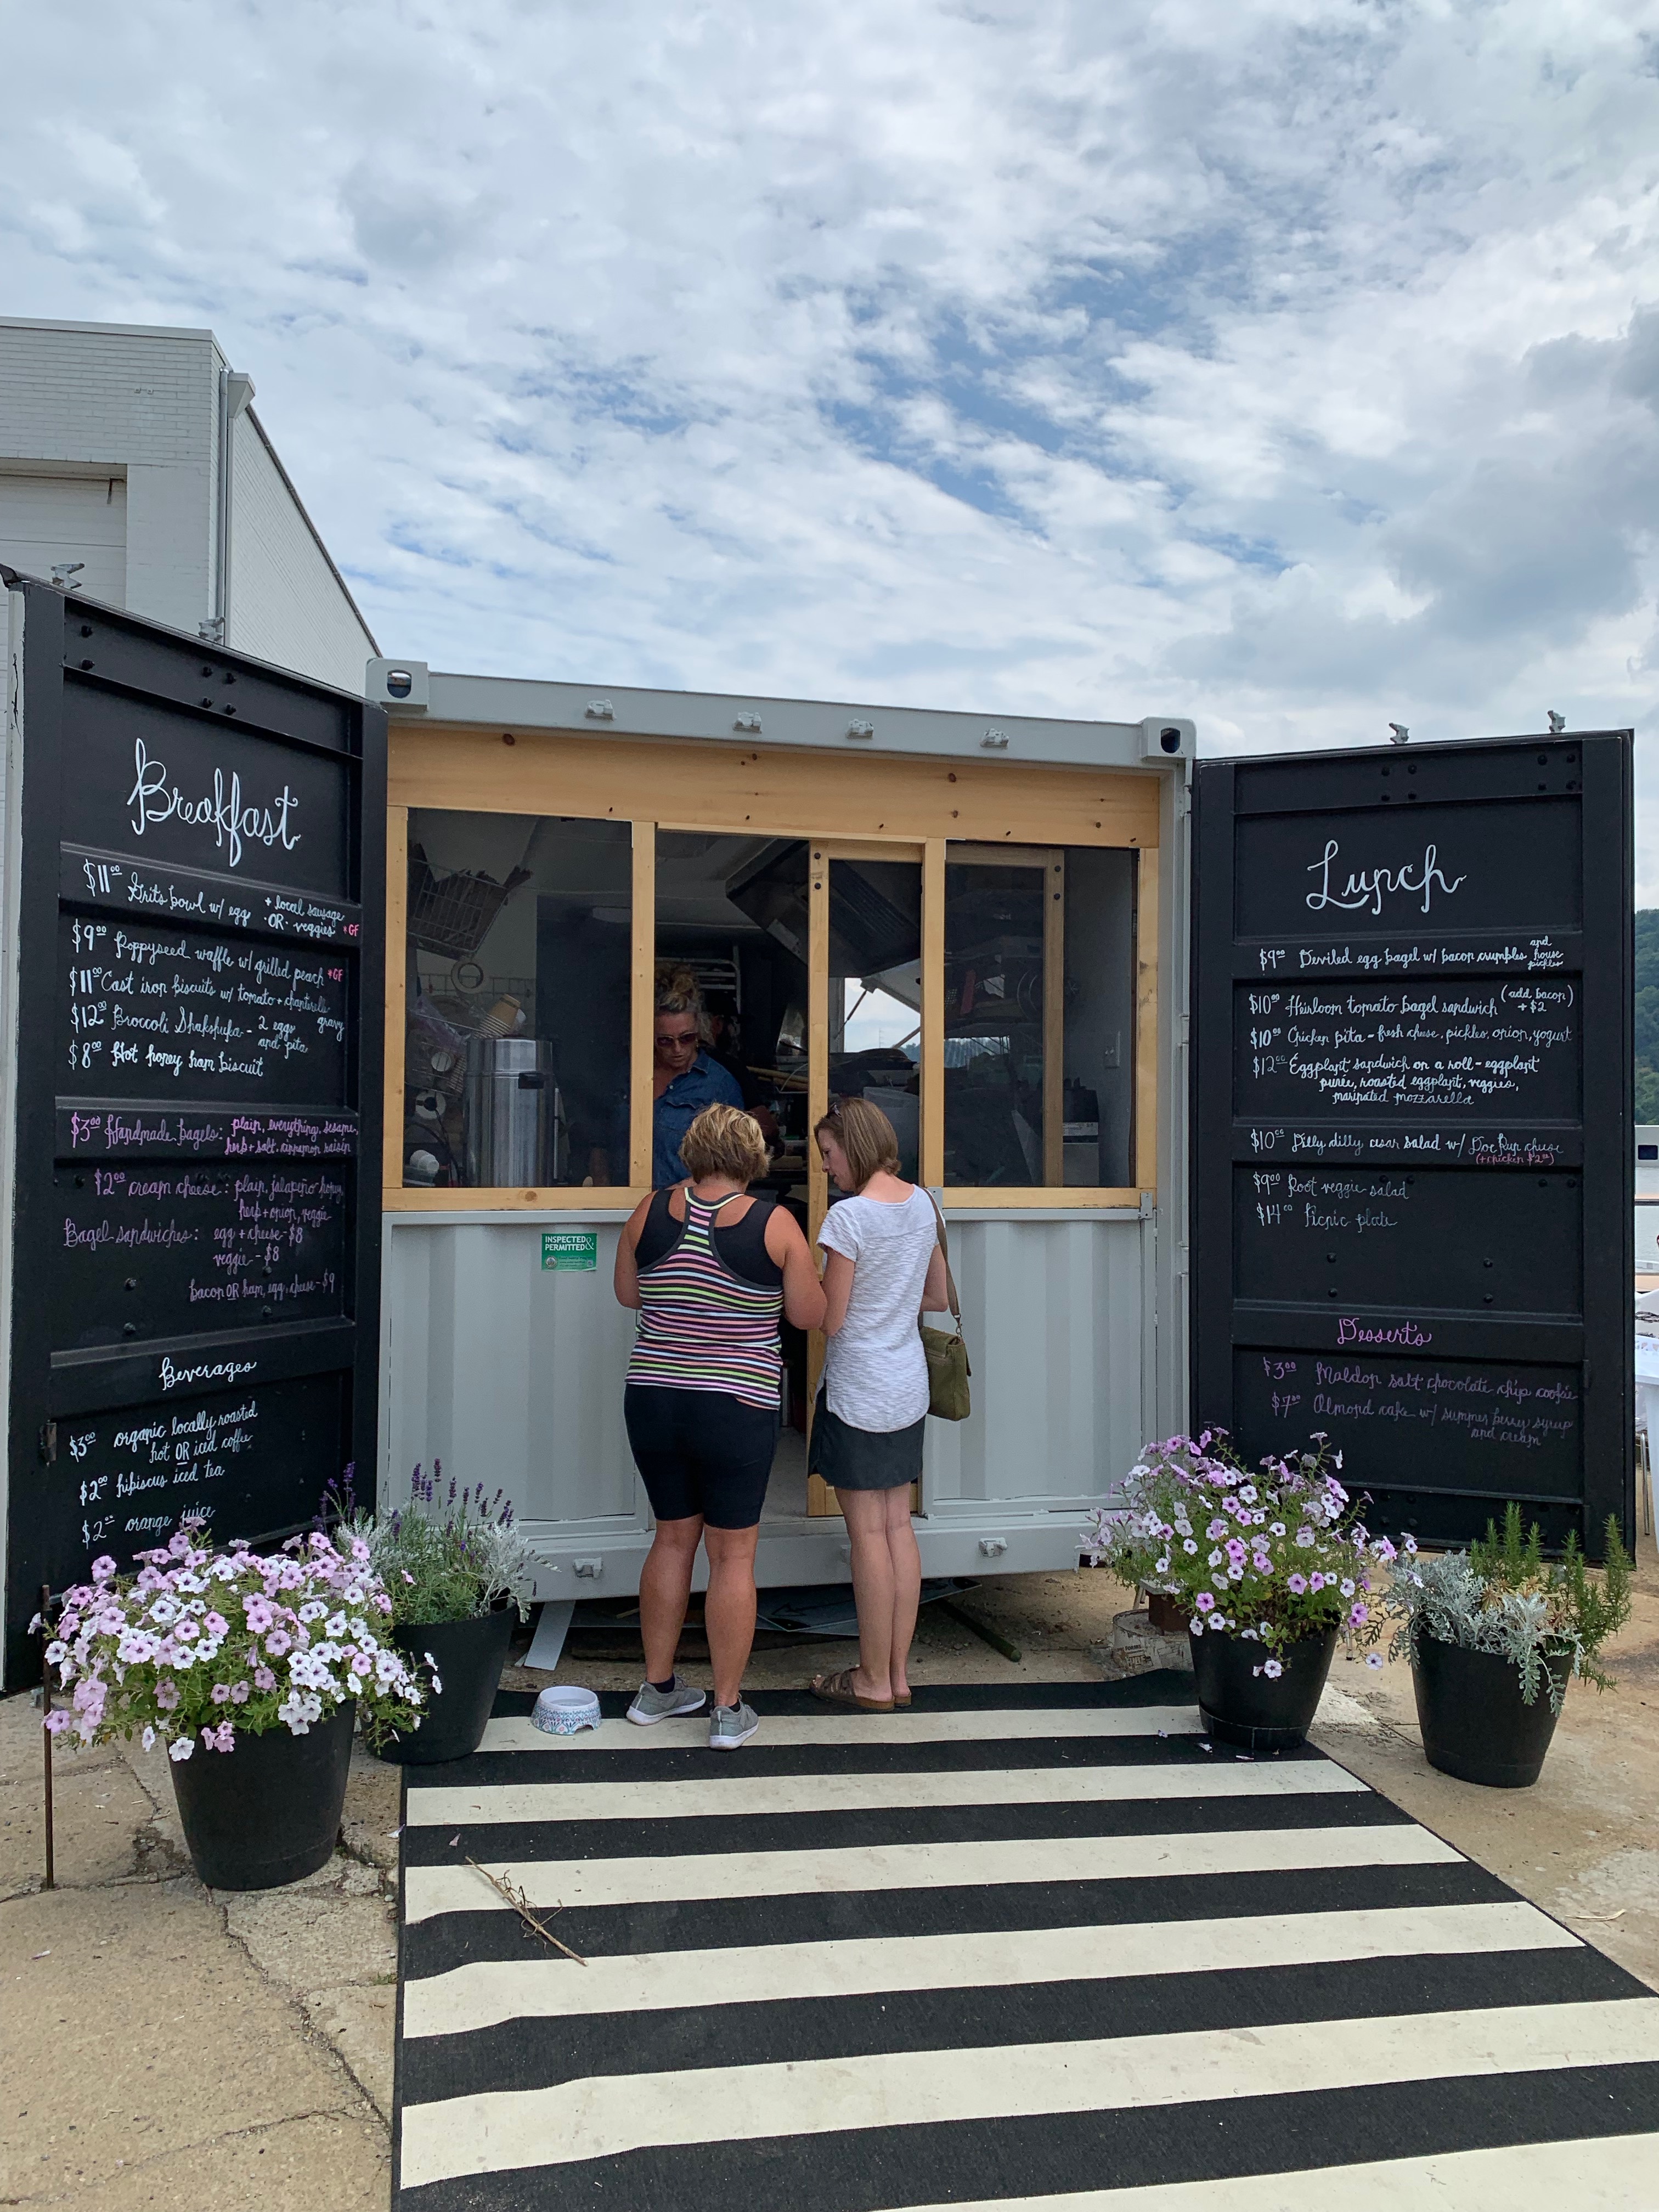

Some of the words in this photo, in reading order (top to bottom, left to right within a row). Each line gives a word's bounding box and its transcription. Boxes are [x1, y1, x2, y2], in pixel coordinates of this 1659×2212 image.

[127, 738, 301, 867] Breakfast
[1306, 839, 1467, 915] Lunch
[128, 872, 168, 905] Grits
[168, 885, 206, 913] bowl
[209, 898, 224, 919] w/
[229, 906, 251, 927] egg
[274, 895, 305, 916] local
[307, 904, 345, 927] sausage
[293, 922, 335, 938] veggies
[1530, 935, 1552, 947] and
[114, 931, 191, 965] Poppyseed
[195, 946, 234, 972] waffle
[239, 950, 253, 970] w/
[255, 957, 291, 984] grilled
[292, 967, 324, 991] peach
[1299, 946, 1352, 969] Deviled
[1356, 955, 1382, 969] egg
[1384, 947, 1420, 969] bagel
[1423, 948, 1437, 963] w/
[1441, 948, 1475, 964] bacon
[1476, 946, 1527, 964] crumbles
[1528, 959, 1564, 970] pickles
[1533, 948, 1564, 961] house
[101, 970, 134, 995] Cast
[140, 977, 167, 997] iron
[172, 974, 216, 998] biscuits
[220, 987, 234, 1003] w/
[238, 983, 275, 1006] tomato
[1285, 995, 1343, 1017] Heirloom
[1346, 995, 1399, 1017] tomato
[1400, 995, 1438, 1020] bagel
[1441, 997, 1498, 1018] sandwich
[111, 1004, 169, 1034] Broccoli
[174, 1006, 244, 1042] Shakshuka
[258, 1015, 268, 1030] 2
[273, 1021, 296, 1041] eggs
[317, 1017, 345, 1042] gravy
[1288, 1025, 1330, 1047] Chicken
[1334, 1026, 1366, 1048] pita
[1377, 1024, 1404, 1042] fresh
[1532, 1025, 1572, 1048] yogurt
[110, 1041, 138, 1066] Hot
[145, 1044, 183, 1076] honey
[189, 1049, 215, 1071] ham
[218, 1051, 263, 1076] biscuit
[258, 1034, 281, 1051] and
[284, 1037, 308, 1059] pita
[1289, 1052, 1351, 1080] Eggplant
[1352, 1053, 1410, 1074] sandwich
[1413, 1060, 1430, 1071] on
[1434, 1060, 1444, 1070] a
[1447, 1056, 1474, 1070] roll
[1485, 1055, 1540, 1079] eggplant
[1359, 1073, 1407, 1090] roasted
[1331, 1088, 1389, 1105] marinated
[1393, 1092, 1474, 1105] mozzarella
[104, 1114, 177, 1149] Handmade
[1291, 1132, 1327, 1156] Dilly
[1328, 1132, 1364, 1156] dilly
[1403, 1133, 1441, 1150] salad
[1445, 1133, 1466, 1158] w/
[1497, 1133, 1521, 1156] Run
[324, 1138, 351, 1154] raisin
[128, 1181, 171, 1200] cream
[1288, 1173, 1317, 1198] Root
[1321, 1180, 1367, 1199] veggie
[1369, 1181, 1409, 1199] salad
[1304, 1203, 1352, 1230] Picnic
[1355, 1208, 1398, 1233] plate
[63, 1218, 114, 1251] Bagel
[213, 1227, 236, 1248] egg
[247, 1224, 284, 1245] cheese
[289, 1223, 303, 1247] $8
[585, 1237, 595, 1250] &
[213, 1248, 253, 1276] veggie
[264, 1243, 279, 1266] $8
[189, 1278, 224, 1302] bacon
[226, 1283, 239, 1301] OR
[1338, 1318, 1431, 1346] Desserts
[159, 1357, 257, 1391] Beverages
[1315, 1362, 1382, 1390] Maldon
[1388, 1373, 1424, 1391] salt
[1427, 1373, 1494, 1394] chocolate
[1497, 1379, 1532, 1405] chip
[1536, 1382, 1578, 1404] cookie
[114, 1421, 167, 1453] organic
[171, 1410, 217, 1440] locally
[217, 1401, 258, 1426] roasted
[1314, 1393, 1374, 1419] Almond
[1378, 1401, 1415, 1421] cake
[1419, 1404, 1437, 1426] w/
[1441, 1408, 1488, 1428] summer
[1492, 1407, 1531, 1436] berry
[1532, 1417, 1573, 1439] syrup
[149, 1442, 170, 1464] hot
[175, 1441, 190, 1465] OR
[193, 1430, 218, 1456] iced
[221, 1428, 253, 1453] coffee
[1471, 1427, 1496, 1440] and
[1500, 1430, 1541, 1448] cream
[116, 1471, 168, 1498] hibiscus
[172, 1463, 199, 1484] iced
[203, 1459, 225, 1478] tea
[125, 1515, 173, 1537] orange
[180, 1501, 216, 1526] juice
